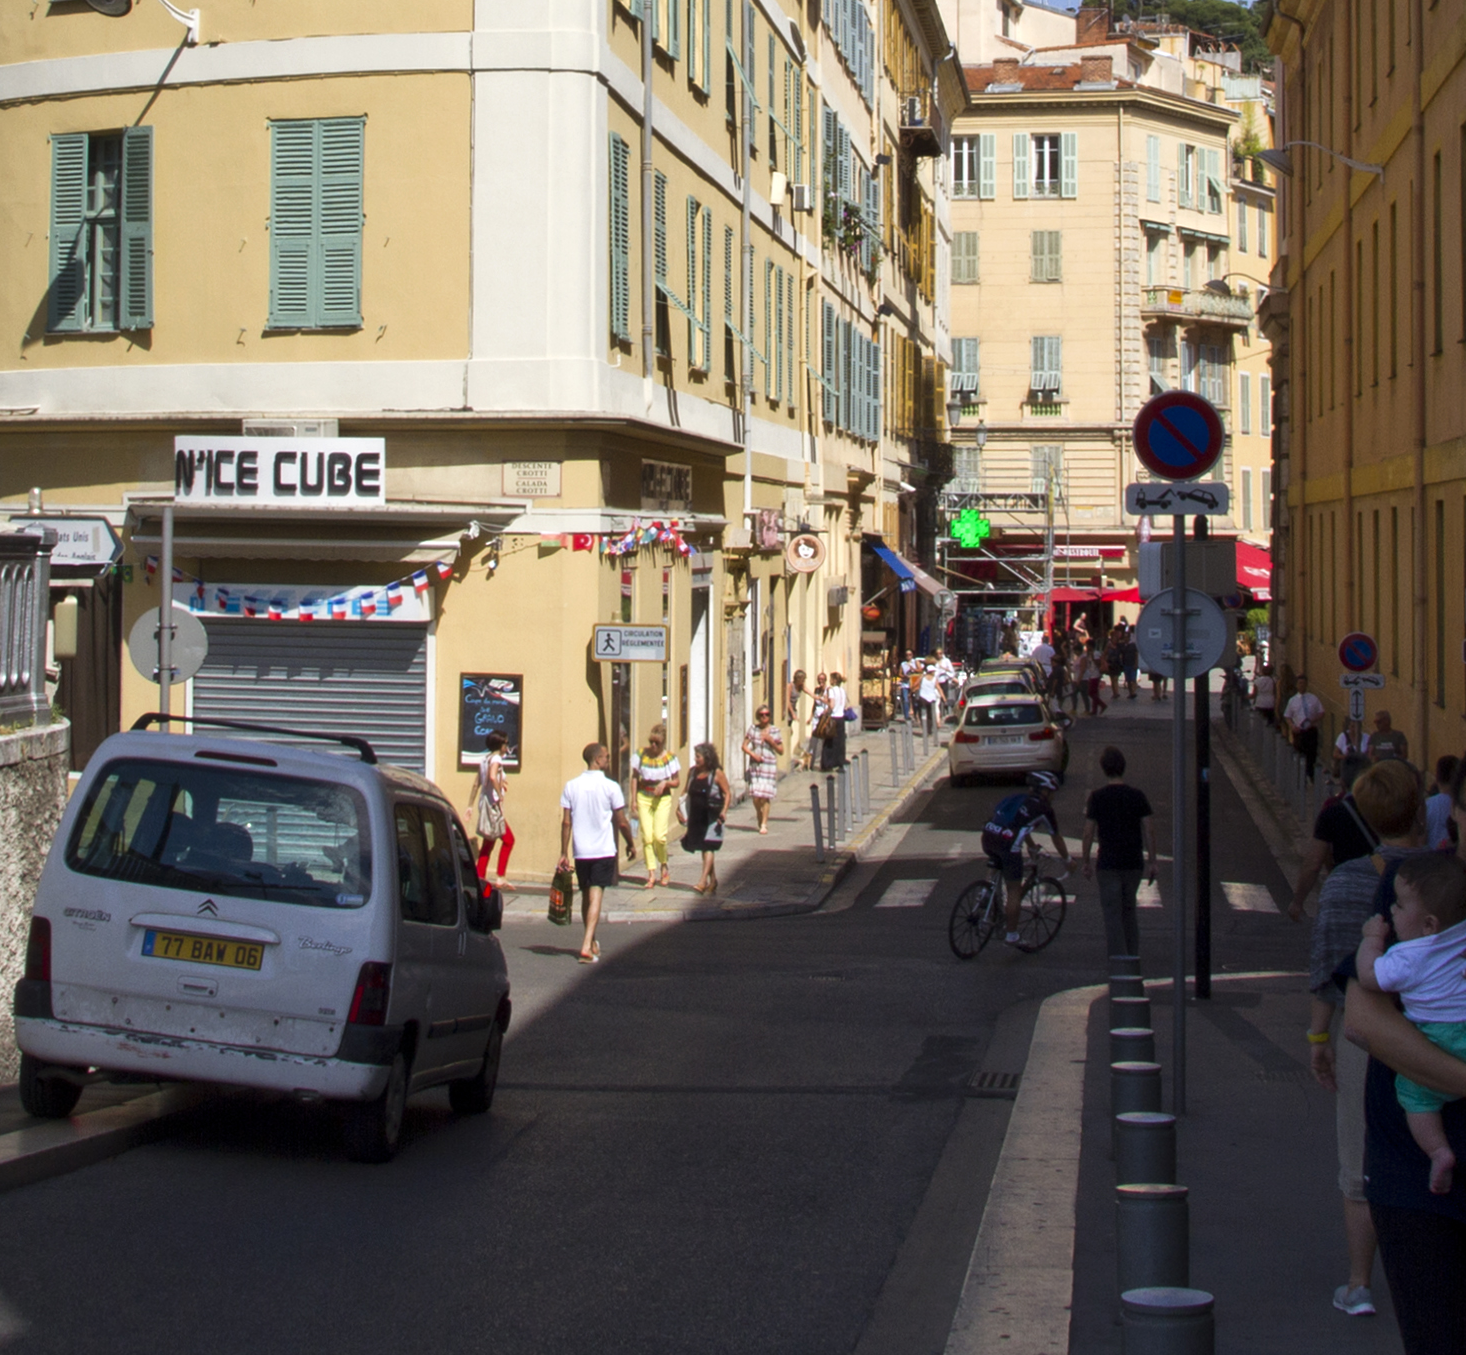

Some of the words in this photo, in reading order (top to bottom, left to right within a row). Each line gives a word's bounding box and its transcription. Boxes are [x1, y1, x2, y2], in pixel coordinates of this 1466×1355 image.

[175, 449, 259, 494] N'ICE
[273, 450, 381, 494] CUBE
[58, 532, 70, 542] ats
[73, 531, 89, 543] Unis
[624, 630, 664, 638] CIRCULATION
[161, 935, 184, 957] 77
[190, 940, 229, 963] BAW
[234, 945, 260, 967] 06
[297, 934, 354, 956] Berlingo
